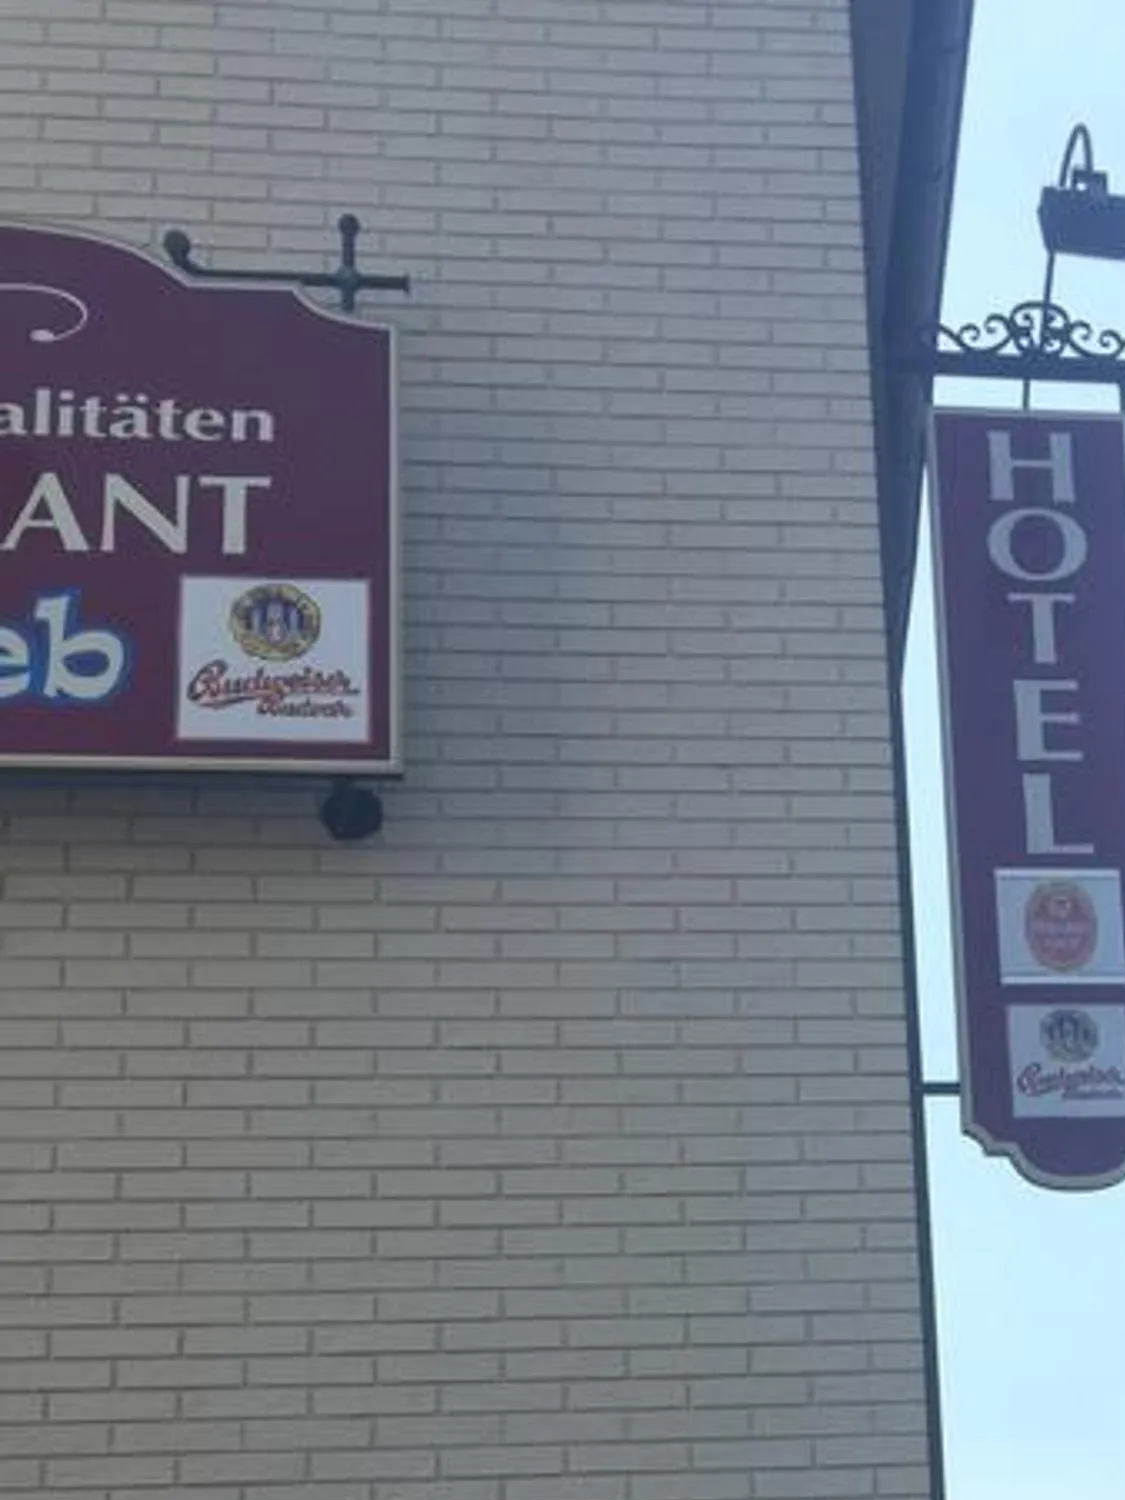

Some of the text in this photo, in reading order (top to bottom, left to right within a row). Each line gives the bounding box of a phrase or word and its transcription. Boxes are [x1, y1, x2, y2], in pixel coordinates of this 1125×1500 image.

[0, 387, 275, 441] alitäten
[0, 472, 272, 555] ANT
[986, 430, 1095, 857] HOTEL
